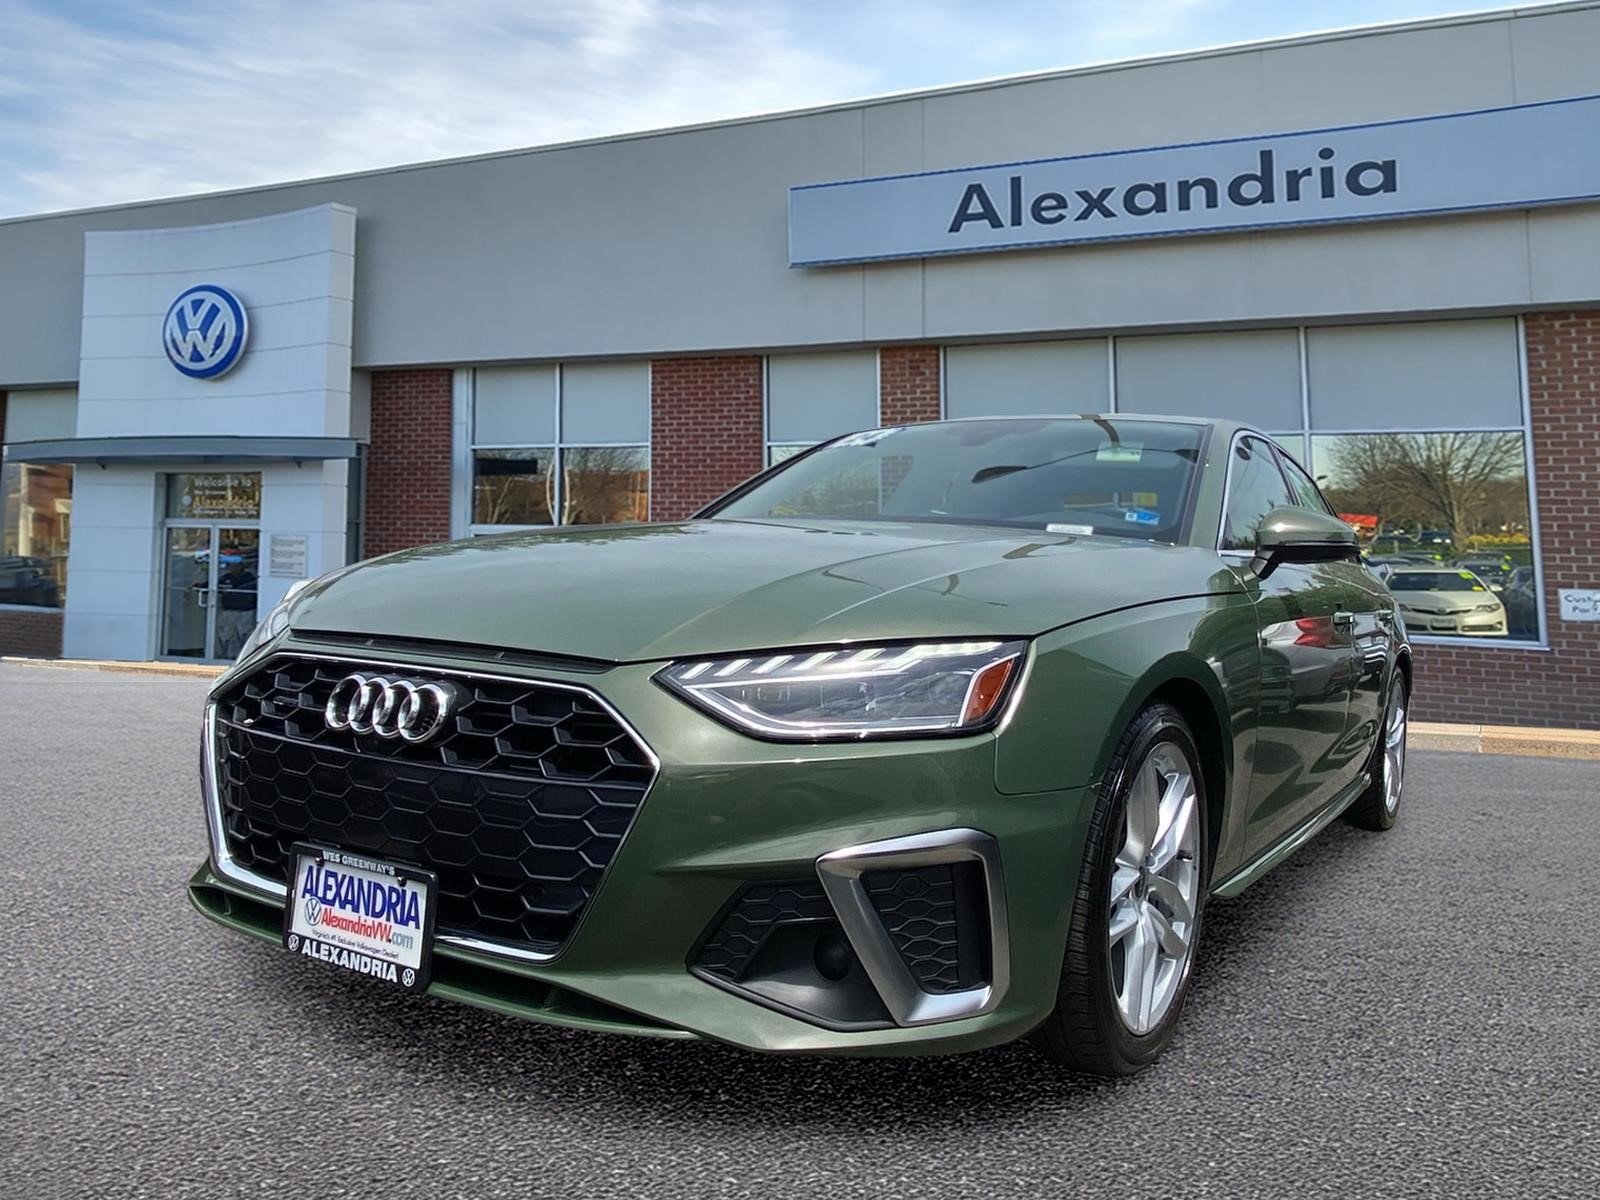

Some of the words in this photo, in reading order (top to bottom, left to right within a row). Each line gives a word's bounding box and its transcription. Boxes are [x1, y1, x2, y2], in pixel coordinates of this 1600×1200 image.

[948, 147, 1398, 233] Alexandria
[194, 477, 240, 487] Welcome
[241, 477, 252, 487] to
[322, 850, 341, 863] WES
[342, 855, 396, 876] GREENWAY'S
[301, 865, 420, 930] ALEXANDRIA
[301, 939, 398, 983] ALEXANDRIA
